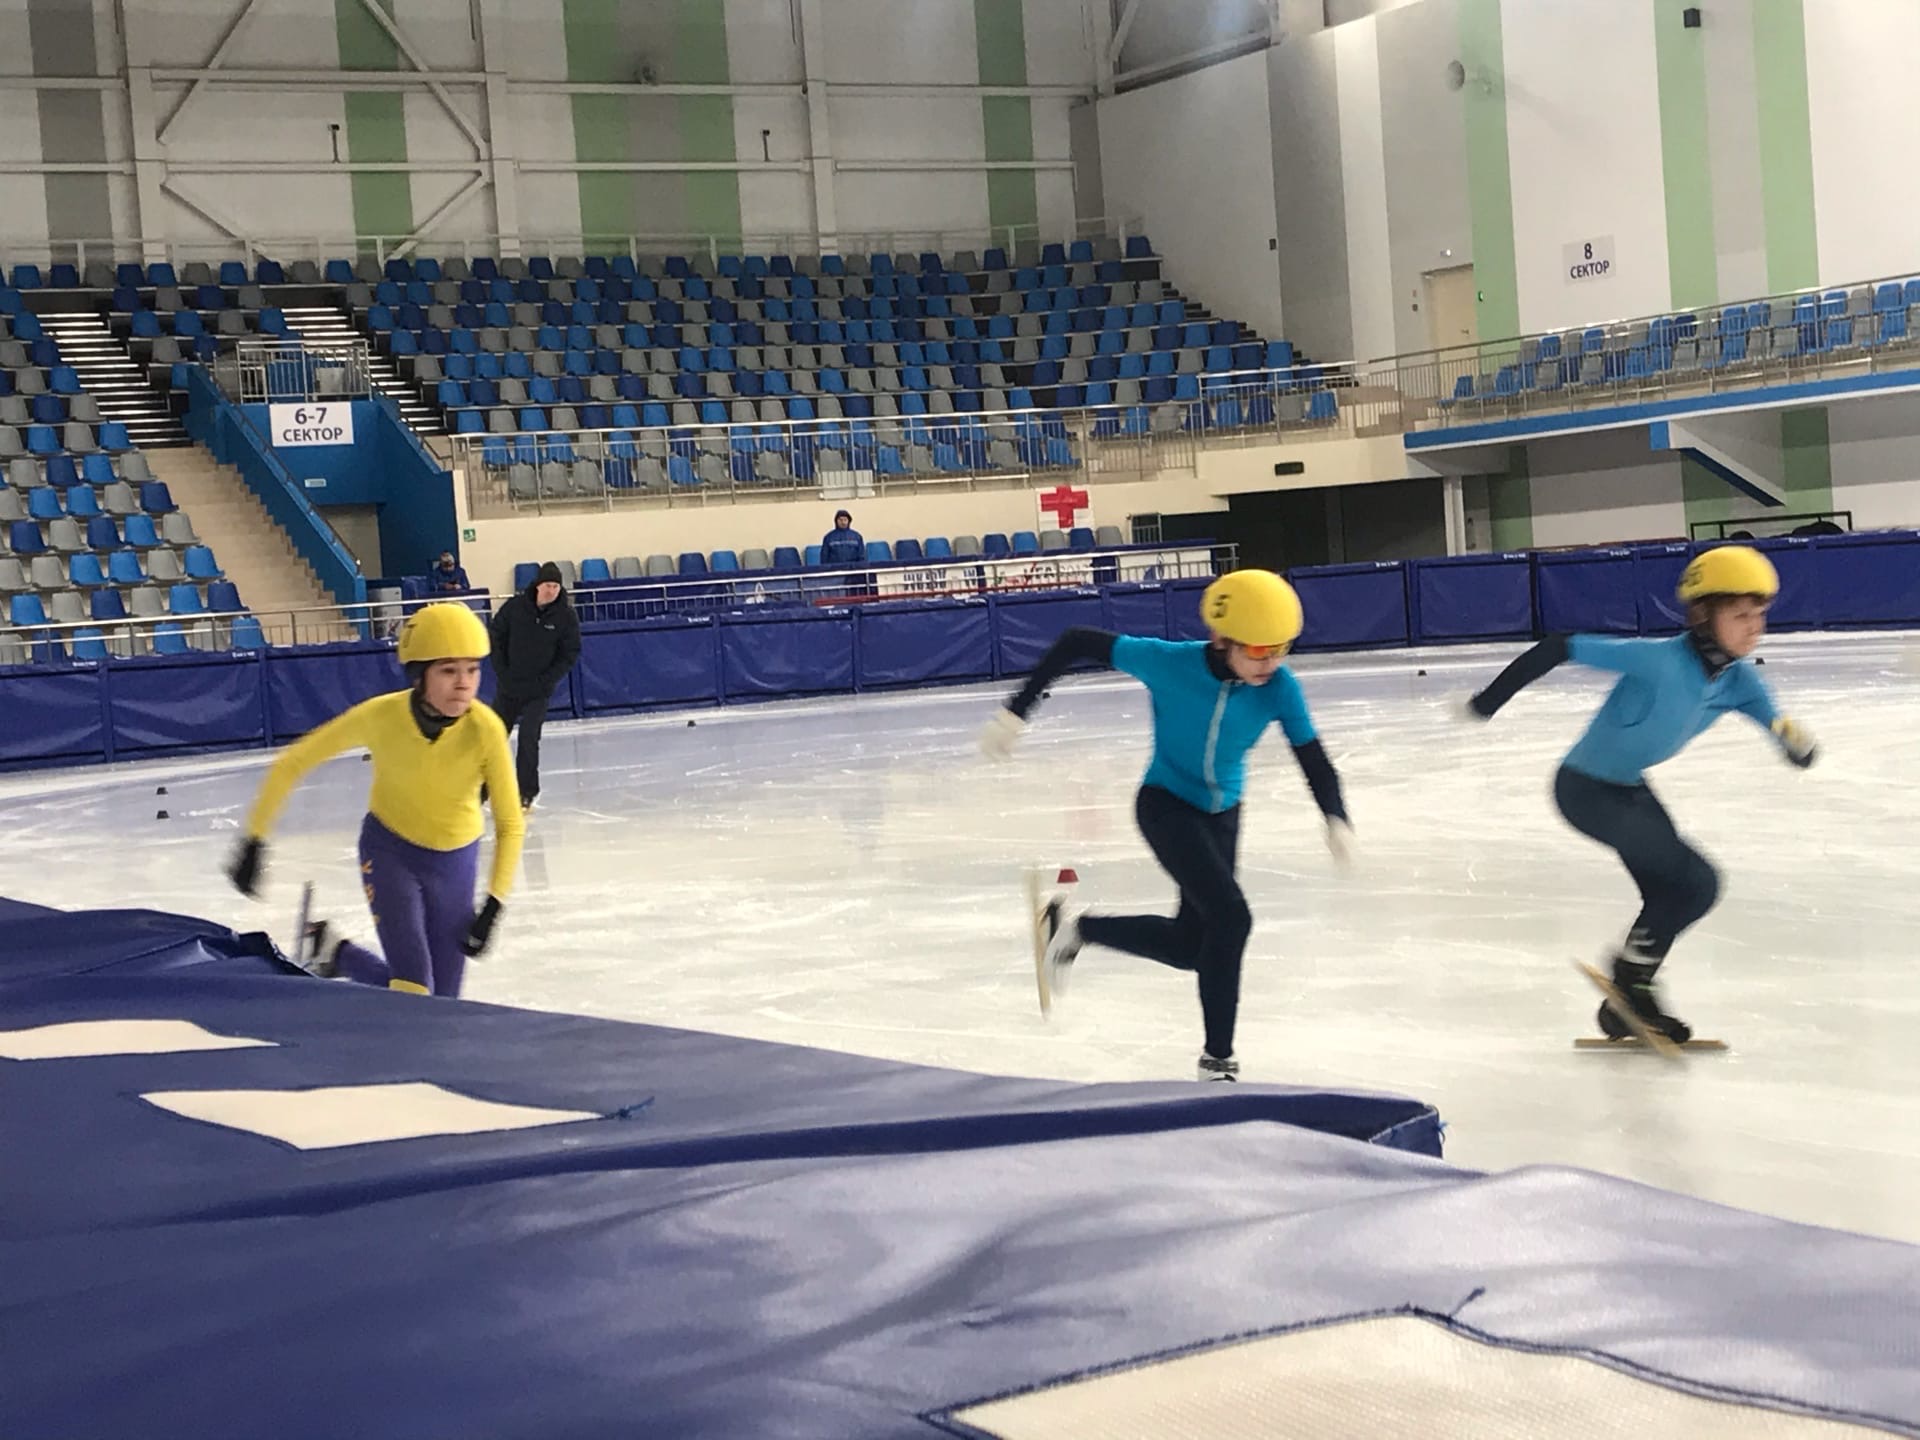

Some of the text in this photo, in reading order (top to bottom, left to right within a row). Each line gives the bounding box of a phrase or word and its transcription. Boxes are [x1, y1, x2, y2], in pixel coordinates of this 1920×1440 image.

[1584, 242, 1593, 260] 8
[1570, 260, 1610, 279] СЕКТОР
[294, 407, 327, 425] 6-7
[282, 427, 343, 442] СЕКТОР
